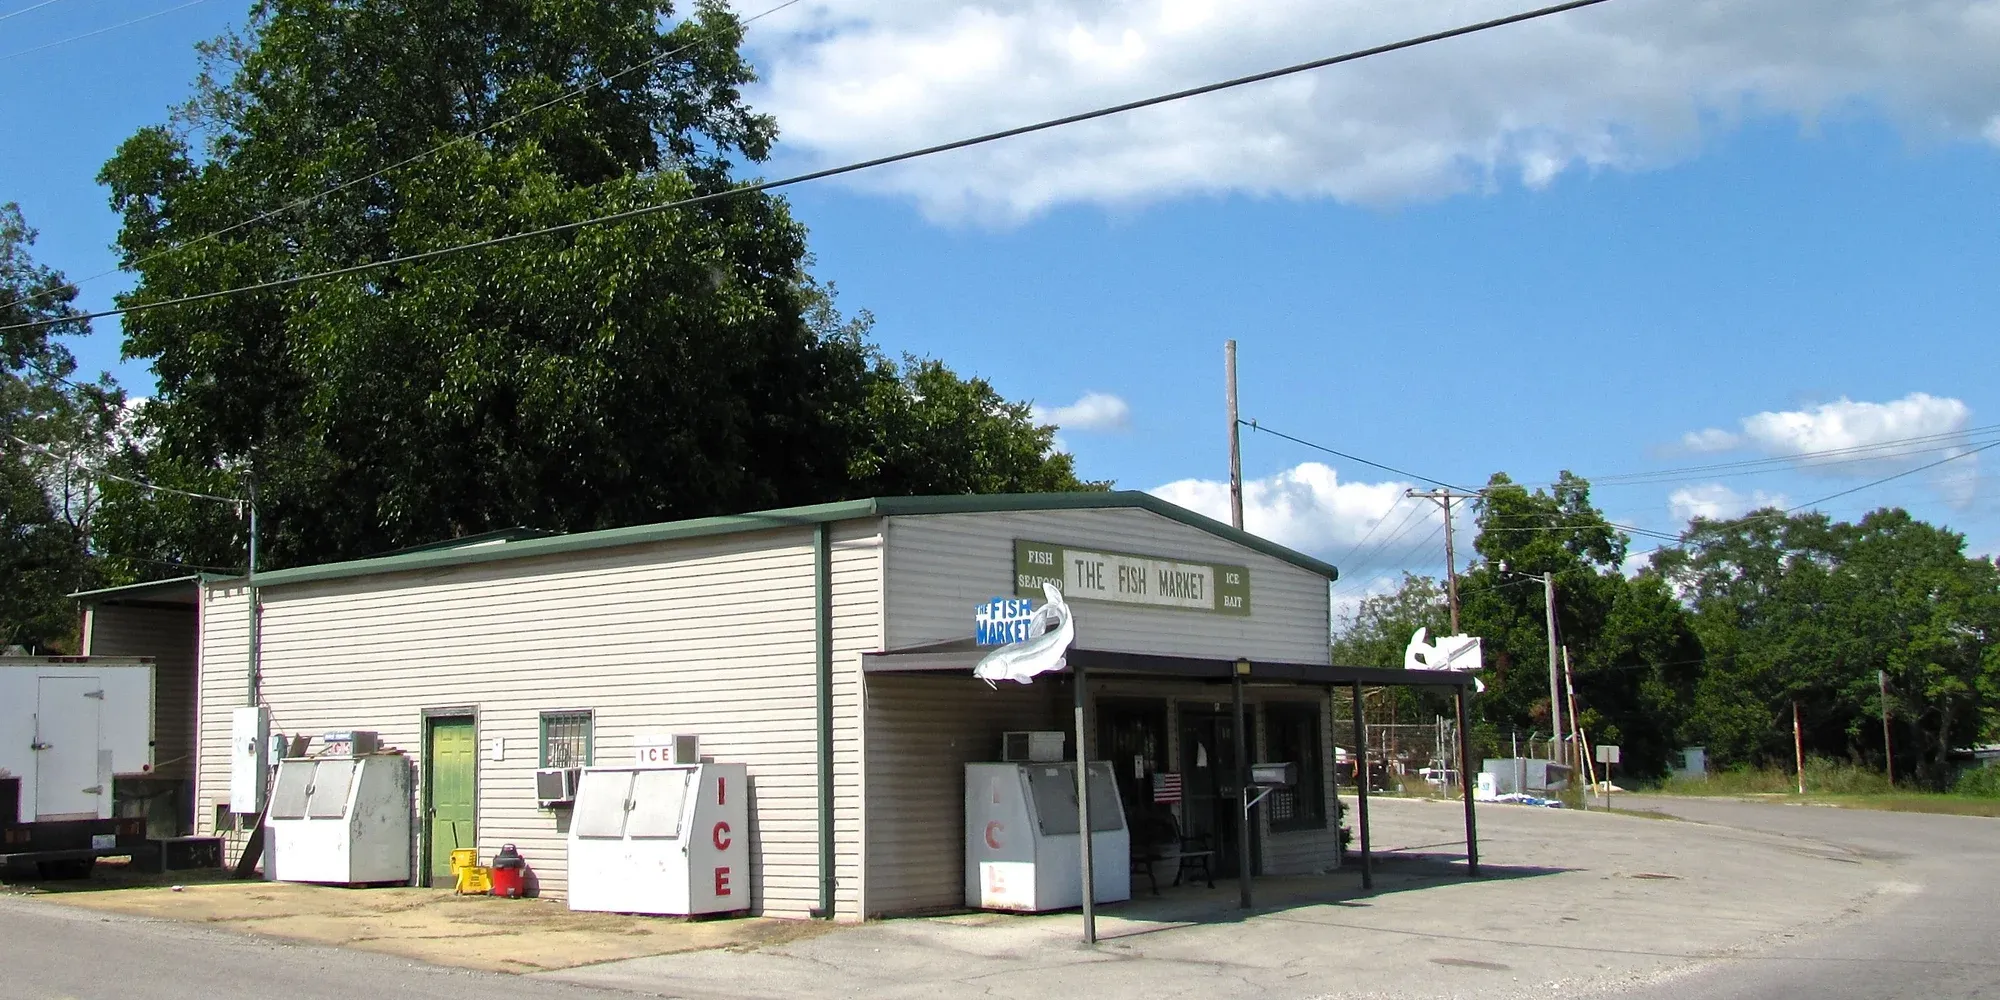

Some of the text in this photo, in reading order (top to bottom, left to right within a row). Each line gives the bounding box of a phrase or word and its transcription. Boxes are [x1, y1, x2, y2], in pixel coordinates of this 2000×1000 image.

[1027, 550, 1053, 565] FISH
[1075, 559, 1204, 600] THE FISH MARKET
[1225, 572, 1240, 584] ICE
[975, 597, 1032, 619] THE FISH
[1223, 595, 1243, 608] BAIT
[976, 618, 1031, 644] MARKET
[640, 748, 669, 762] ICE
[712, 776, 731, 896] ICE
